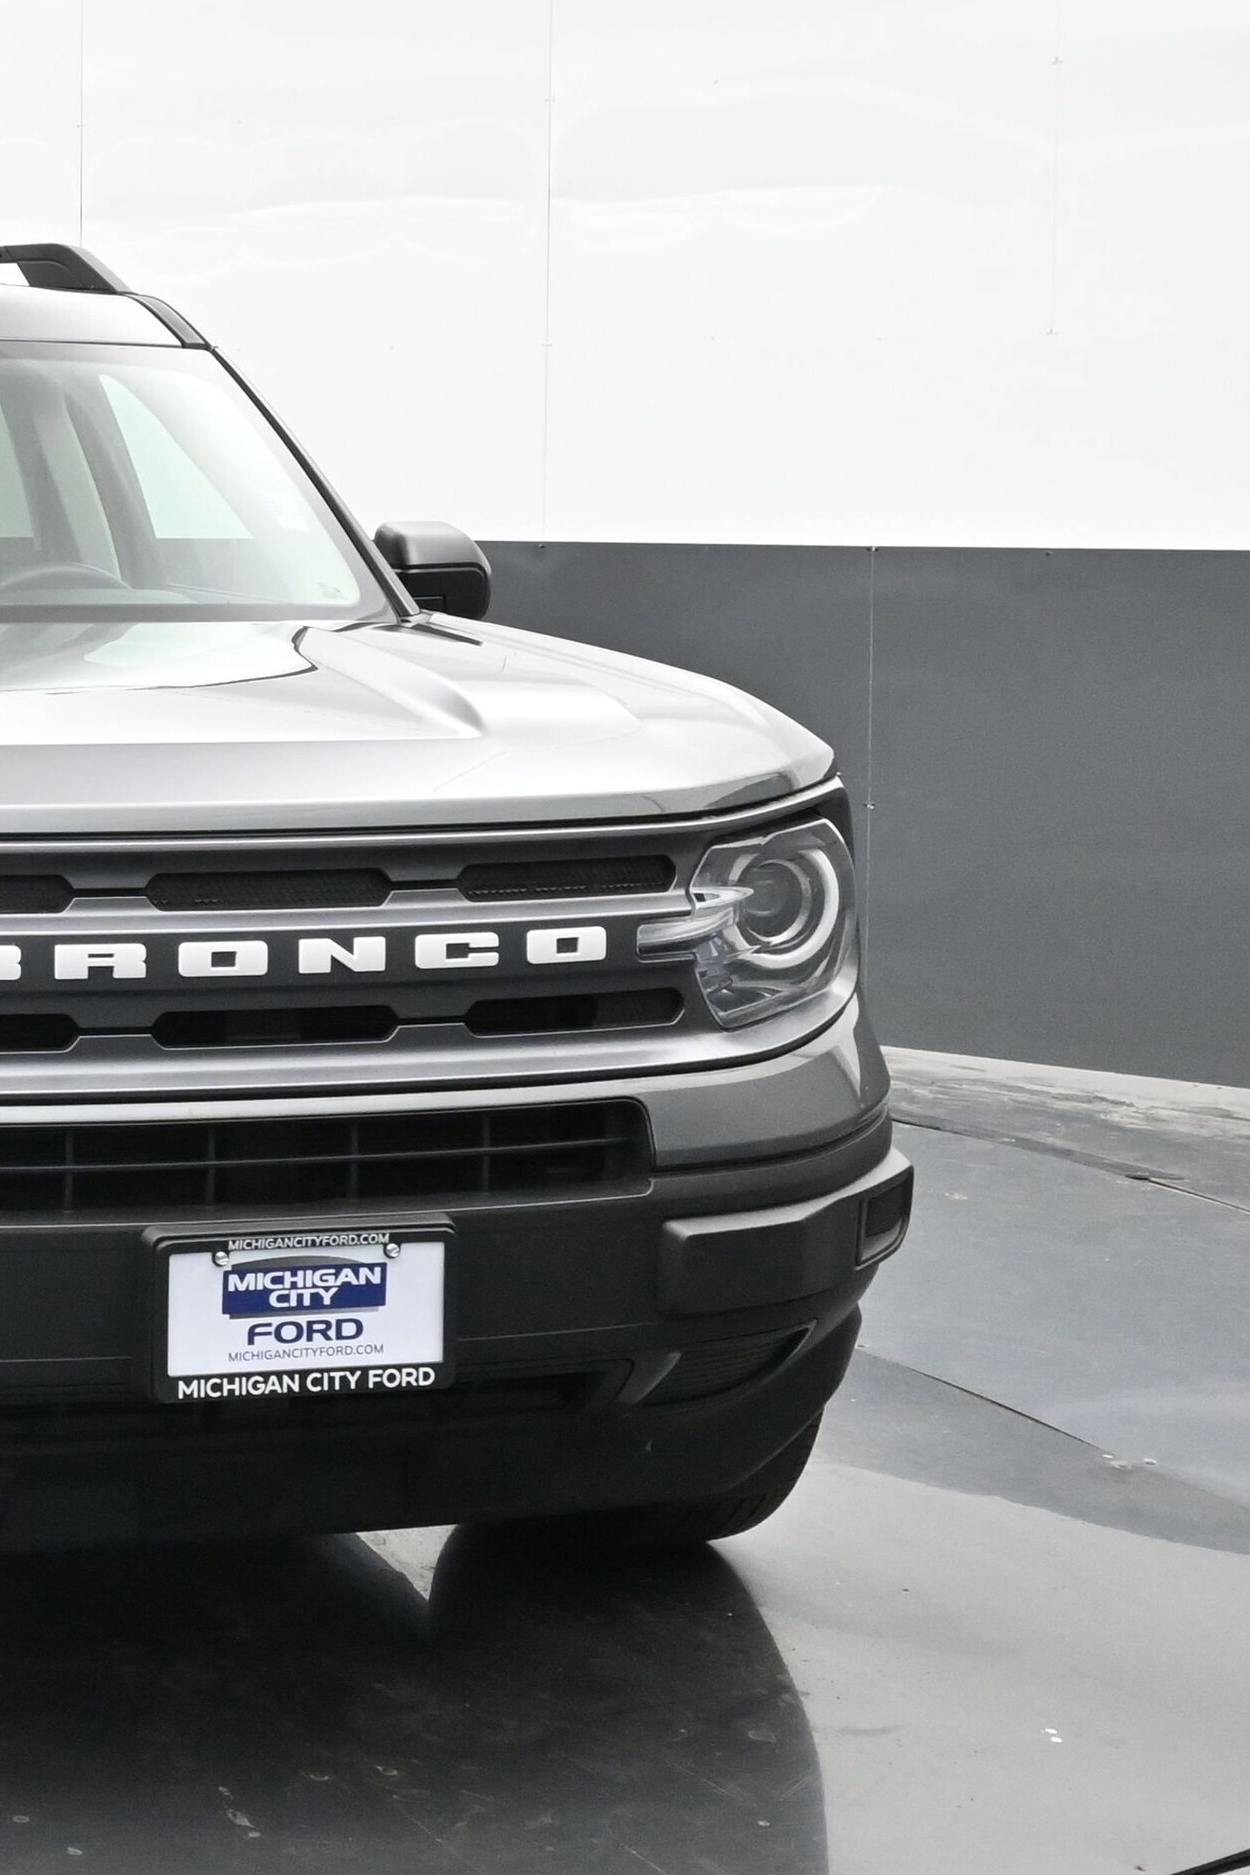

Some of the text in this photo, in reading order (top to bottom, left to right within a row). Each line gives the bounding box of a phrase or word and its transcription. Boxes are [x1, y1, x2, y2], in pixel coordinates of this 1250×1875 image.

[228, 1233, 390, 1250] MICHIGANCITYFORD.COM
[227, 1267, 382, 1292] MICHIGAN
[269, 1287, 339, 1308] CITY
[247, 1318, 364, 1345] FORD
[228, 1344, 384, 1362] MICHIGANCITYFORD.COM
[178, 1367, 436, 1399] MICHIGAN CITY FORD
